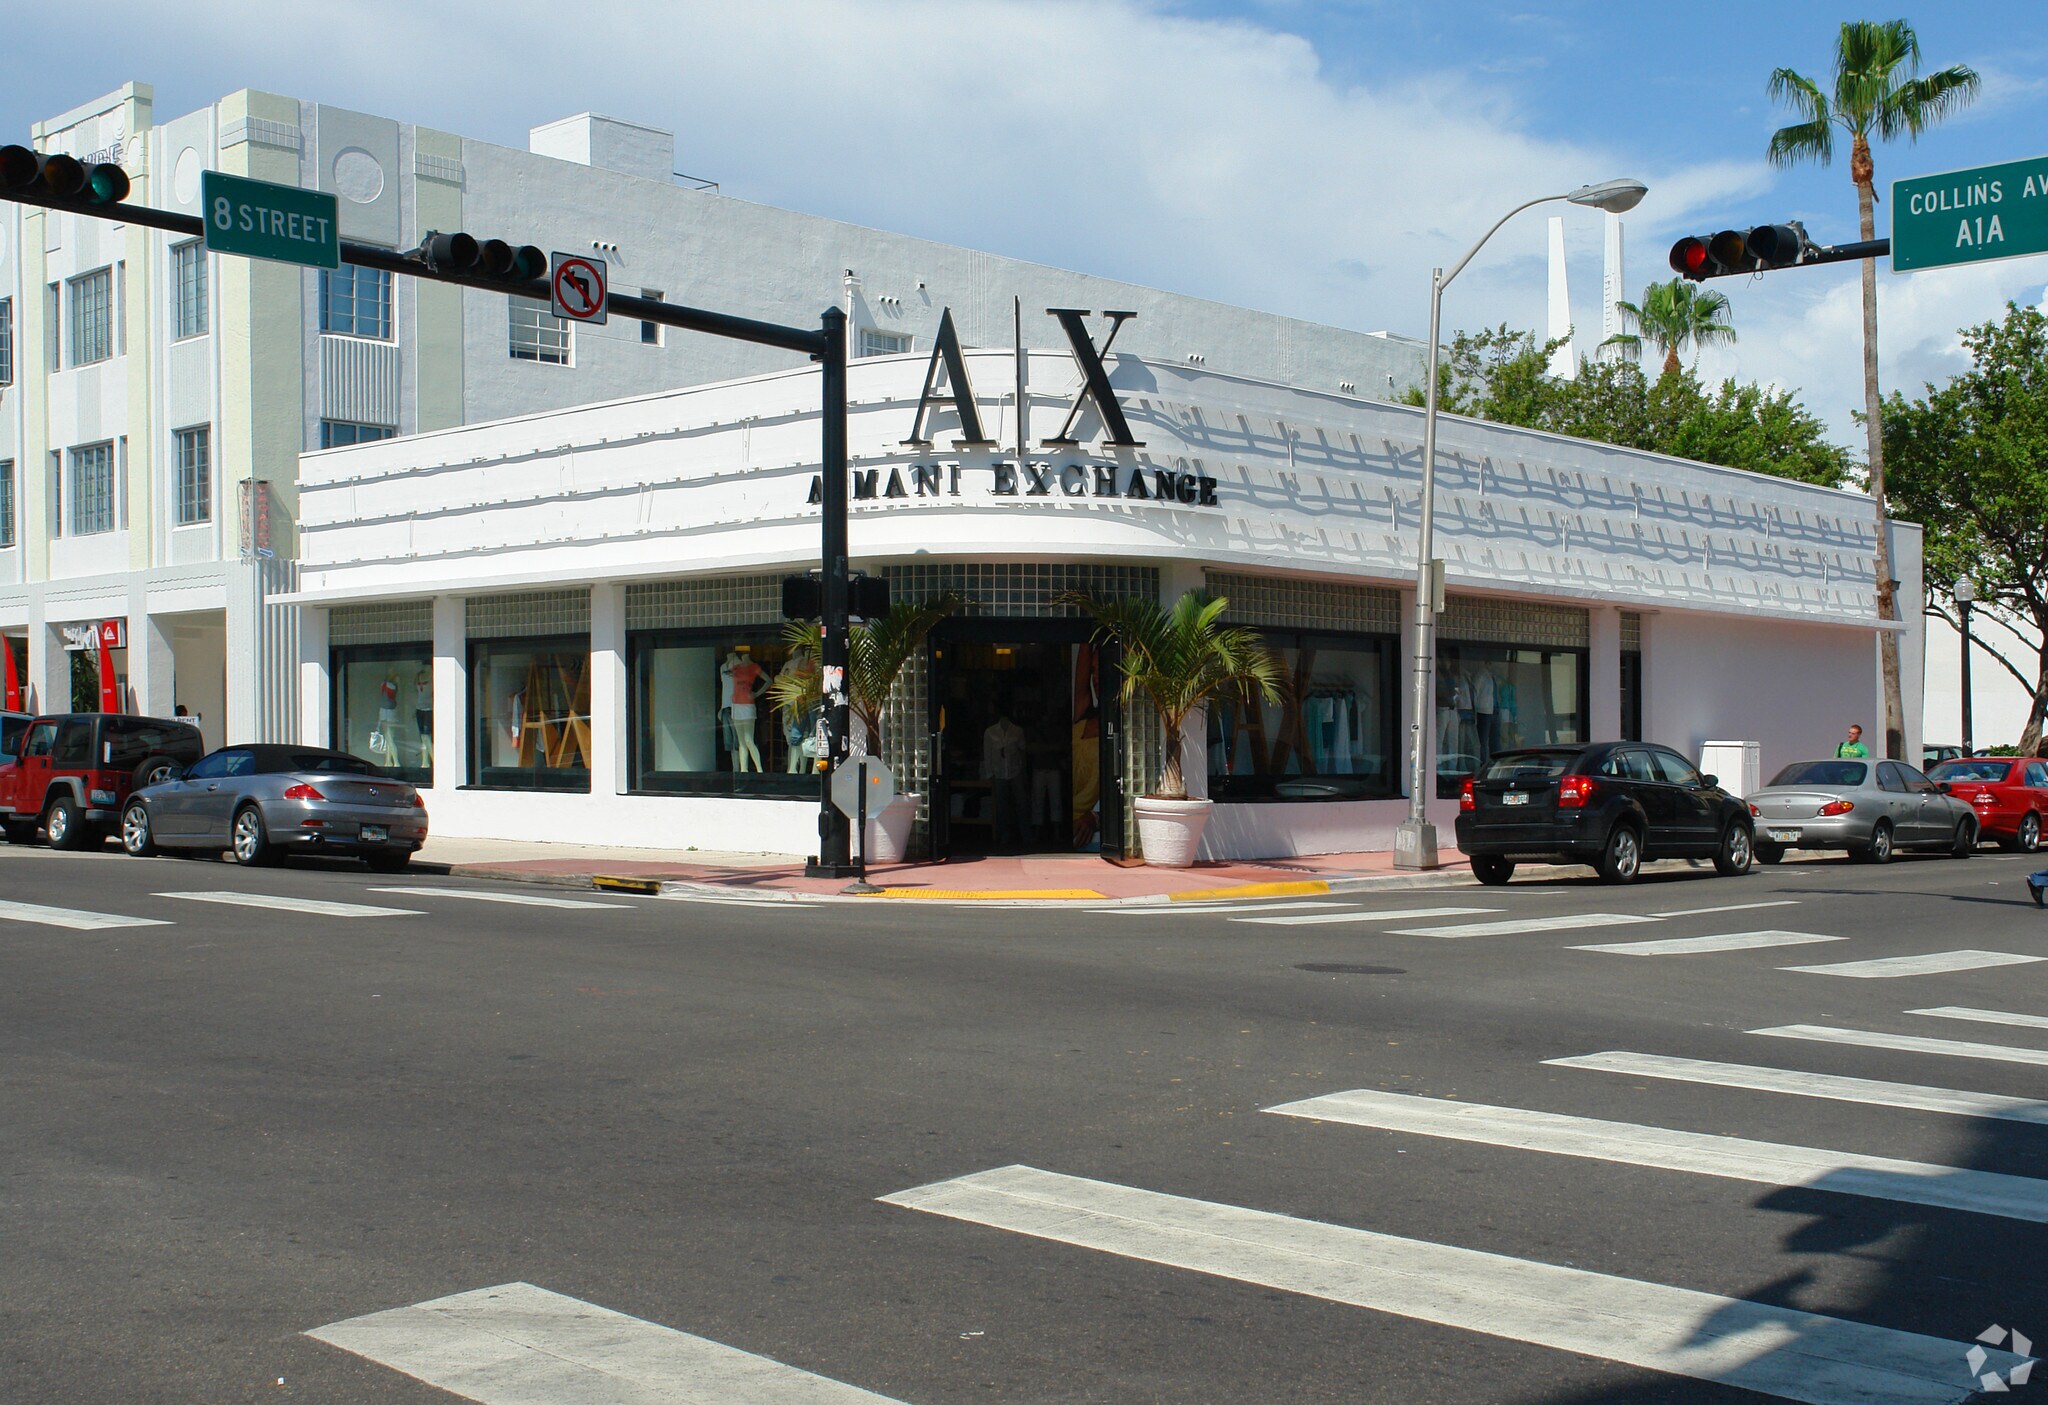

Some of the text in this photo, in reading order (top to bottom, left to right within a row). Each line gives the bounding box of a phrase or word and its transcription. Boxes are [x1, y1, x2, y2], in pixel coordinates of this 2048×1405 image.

[1910, 180, 2003, 215] COLLINS
[214, 196, 329, 244] 8 STREET
[1955, 214, 2005, 248] A1A
[807, 462, 1218, 506] AMANI EXCHANGE
